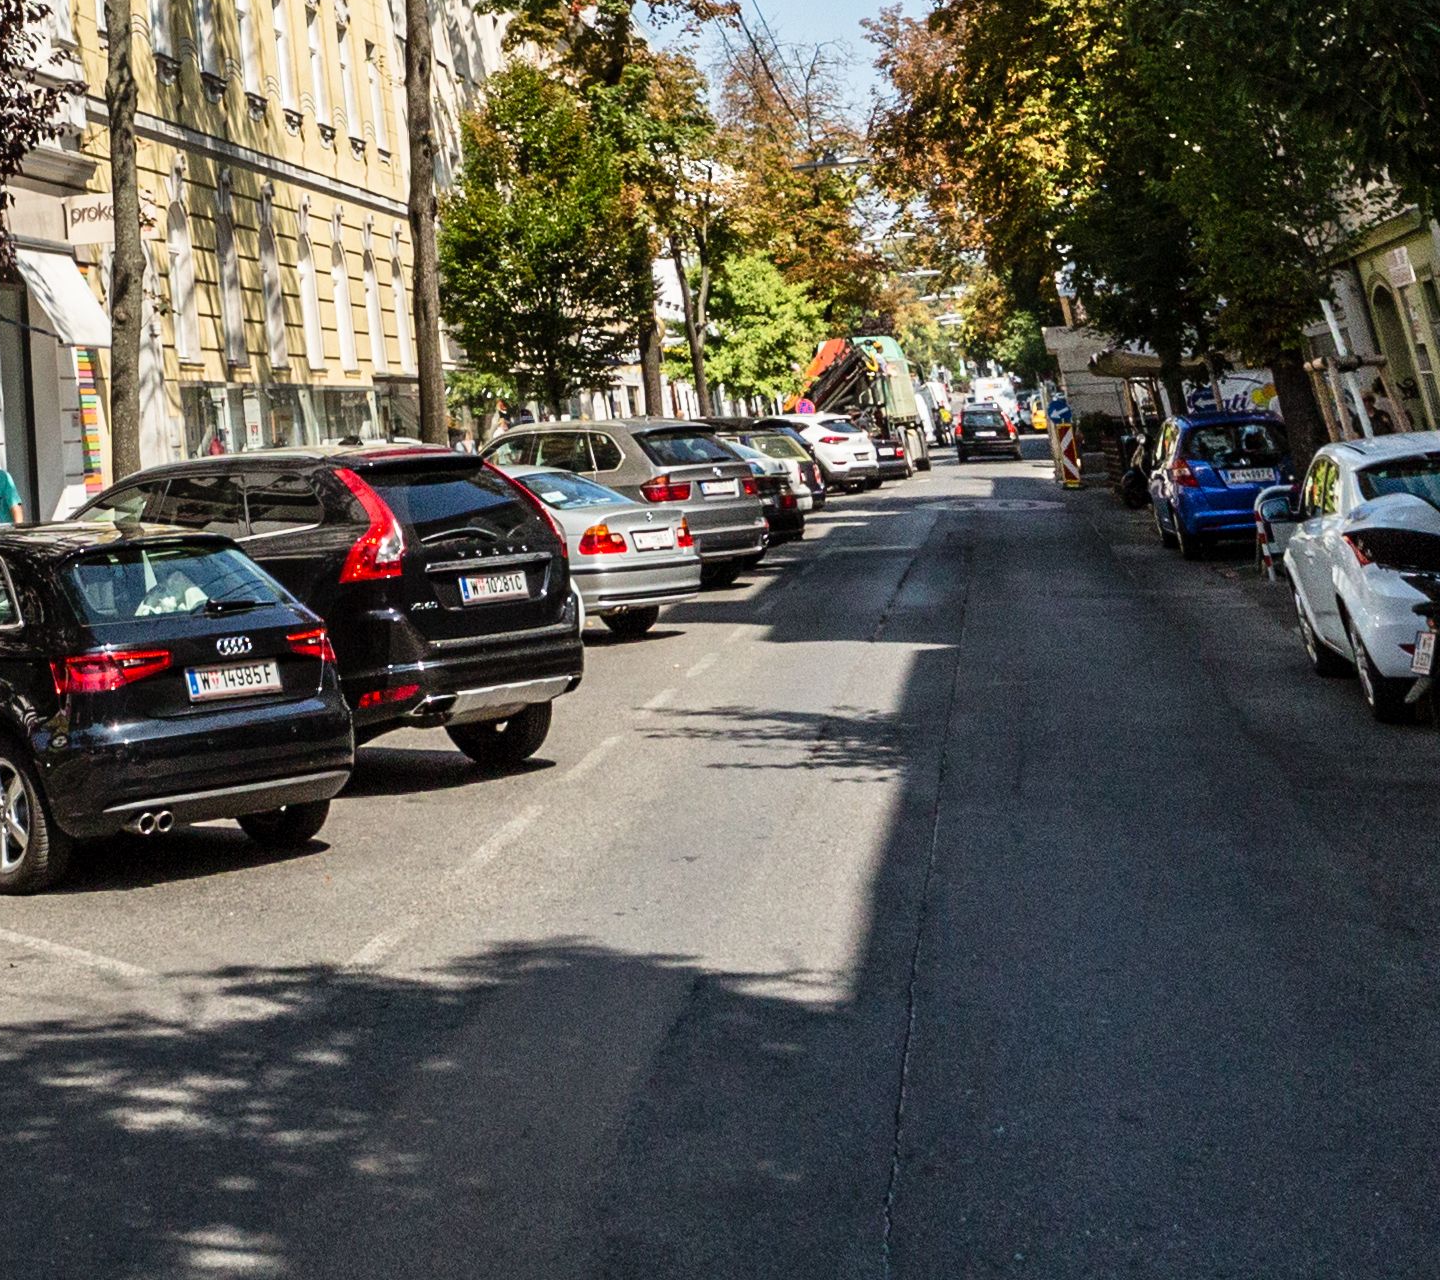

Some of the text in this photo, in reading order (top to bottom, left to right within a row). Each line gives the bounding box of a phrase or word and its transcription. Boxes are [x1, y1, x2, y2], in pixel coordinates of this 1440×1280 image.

[469, 579, 480, 597] W
[199, 663, 272, 690] W 14985 F
